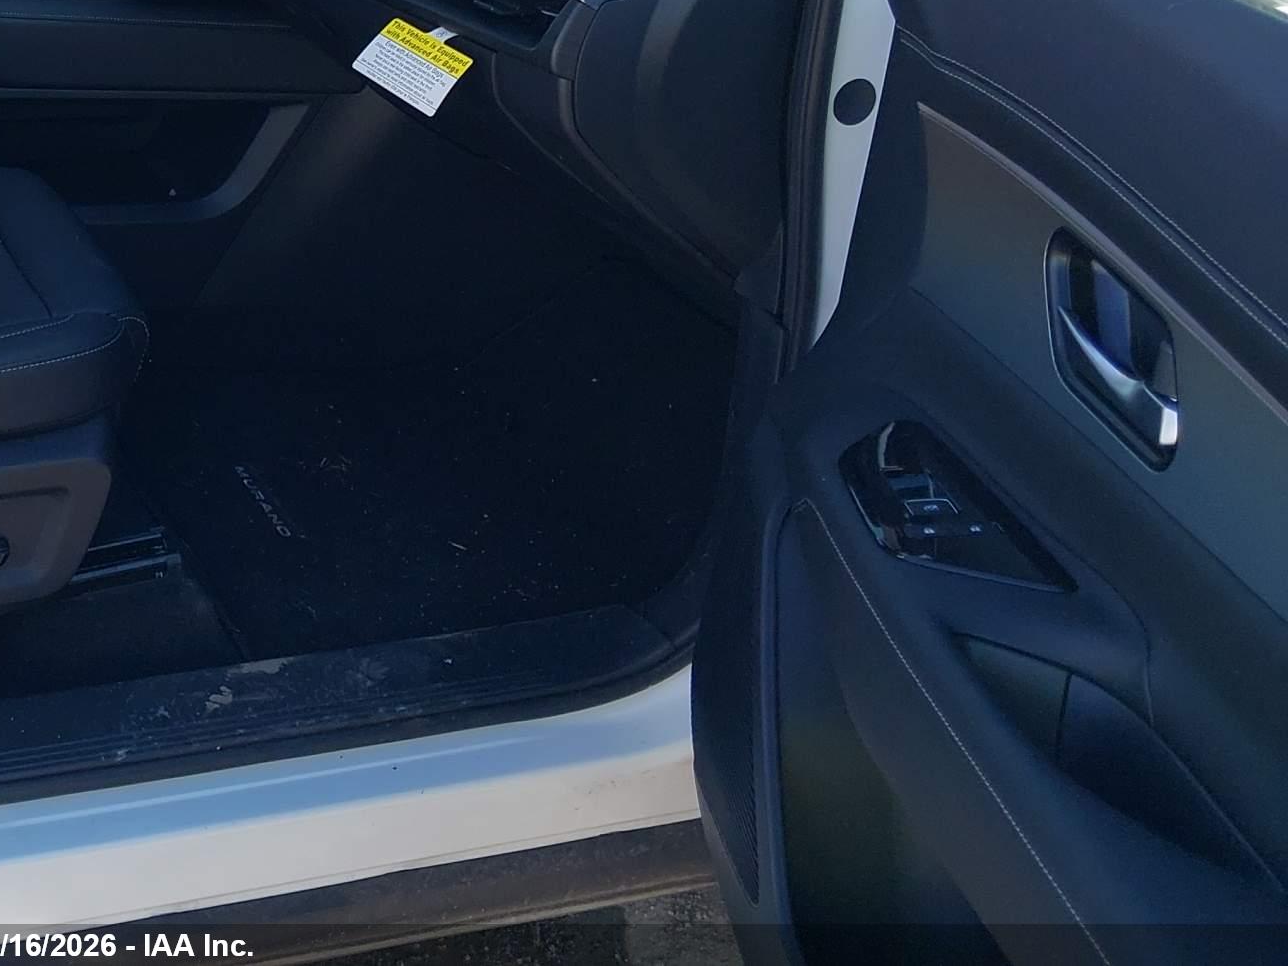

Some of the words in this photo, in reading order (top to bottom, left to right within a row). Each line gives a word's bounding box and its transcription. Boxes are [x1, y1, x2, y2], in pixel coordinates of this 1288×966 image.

[386, 30, 401, 39] with
[399, 37, 433, 56] Advanced
[431, 54, 442, 63] Air
[442, 60, 459, 74] Bags
[392, 21, 405, 32] This
[406, 29, 429, 45] Vehicle
[437, 46, 469, 67] Equipped
[235, 466, 291, 537] MURANO
